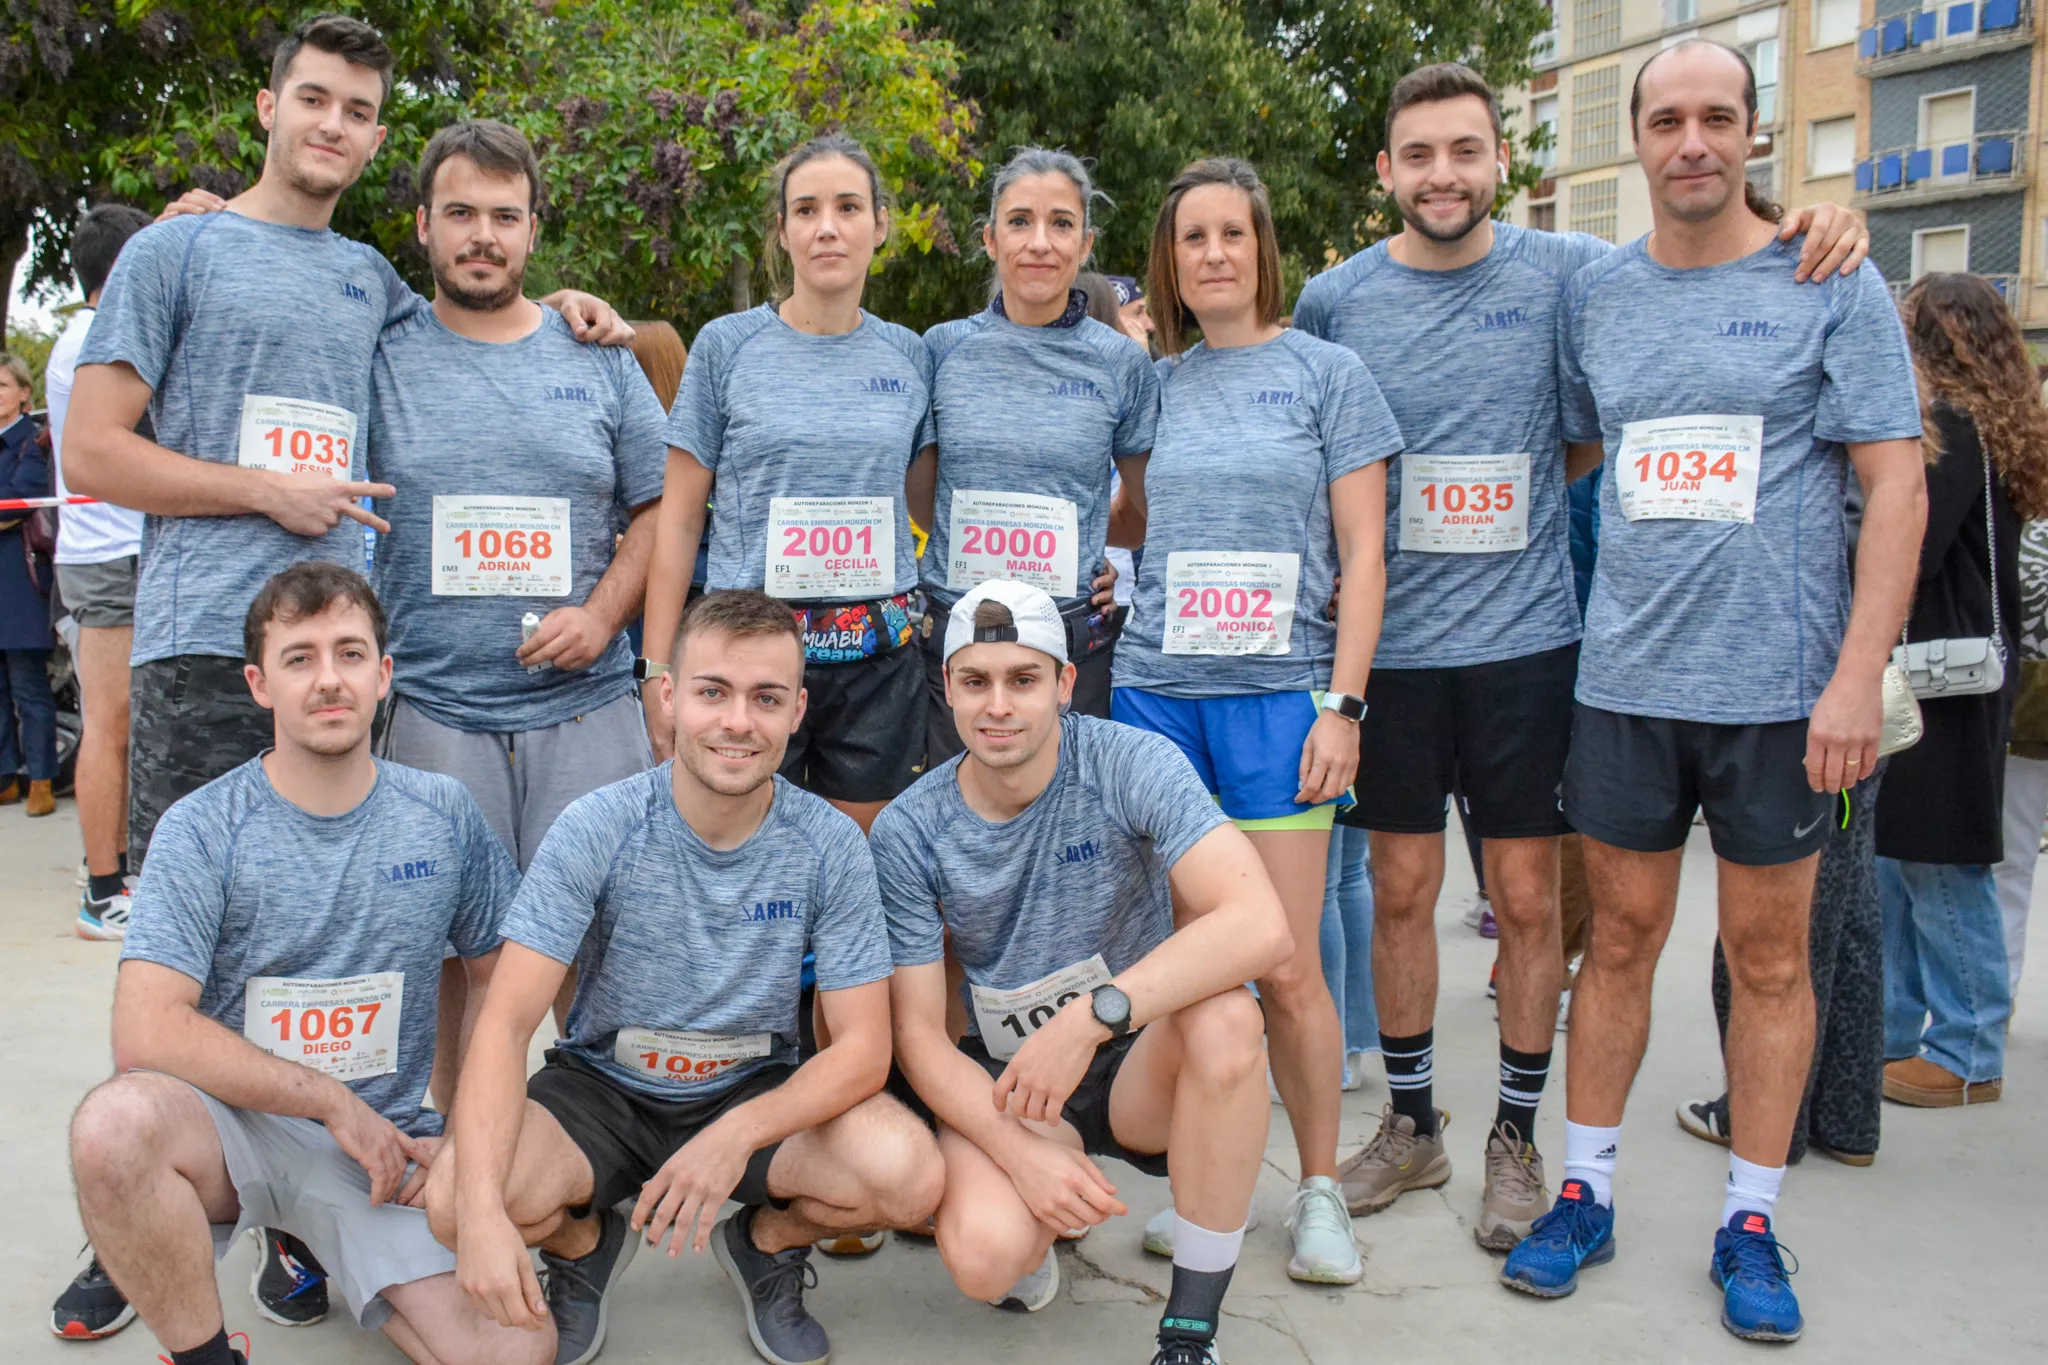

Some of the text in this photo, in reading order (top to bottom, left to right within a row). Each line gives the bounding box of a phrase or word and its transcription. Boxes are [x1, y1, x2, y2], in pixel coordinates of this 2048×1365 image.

[256, 418, 290, 427] CARRERA
[265, 427, 348, 468] 1033
[1701, 442, 1736, 451] MONZÓN
[1634, 451, 1737, 482] 1034
[1660, 481, 1700, 491] JUAN
[1420, 483, 1514, 512] 1035
[1442, 515, 1494, 524] ADRIAN
[455, 530, 552, 559] 1068
[783, 526, 872, 556] 2001
[961, 526, 1056, 559] 2000
[477, 561, 530, 571] ADRIAN
[825, 558, 878, 570] CECILIA
[1006, 560, 1052, 573] MARIA
[1179, 588, 1272, 618] 2002
[1216, 621, 1276, 632] MONICA
[802, 630, 863, 650] MUABU
[301, 999, 344, 1008] EMPRESAS
[346, 994, 379, 1005] MONZÓN
[1014, 996, 1053, 1013] EMPRESAS
[1054, 980, 1085, 997] MONZÓN
[1086, 975, 1098, 983] CM
[271, 1002, 381, 1041] 1067
[654, 1032, 711, 1042] AUTOREPARACIONES
[304, 1040, 352, 1054] DIEGO
[631, 1044, 668, 1054] CARRERA
[670, 1049, 712, 1059] EMPRESAS
[714, 1050, 748, 1059] MONZÓN
